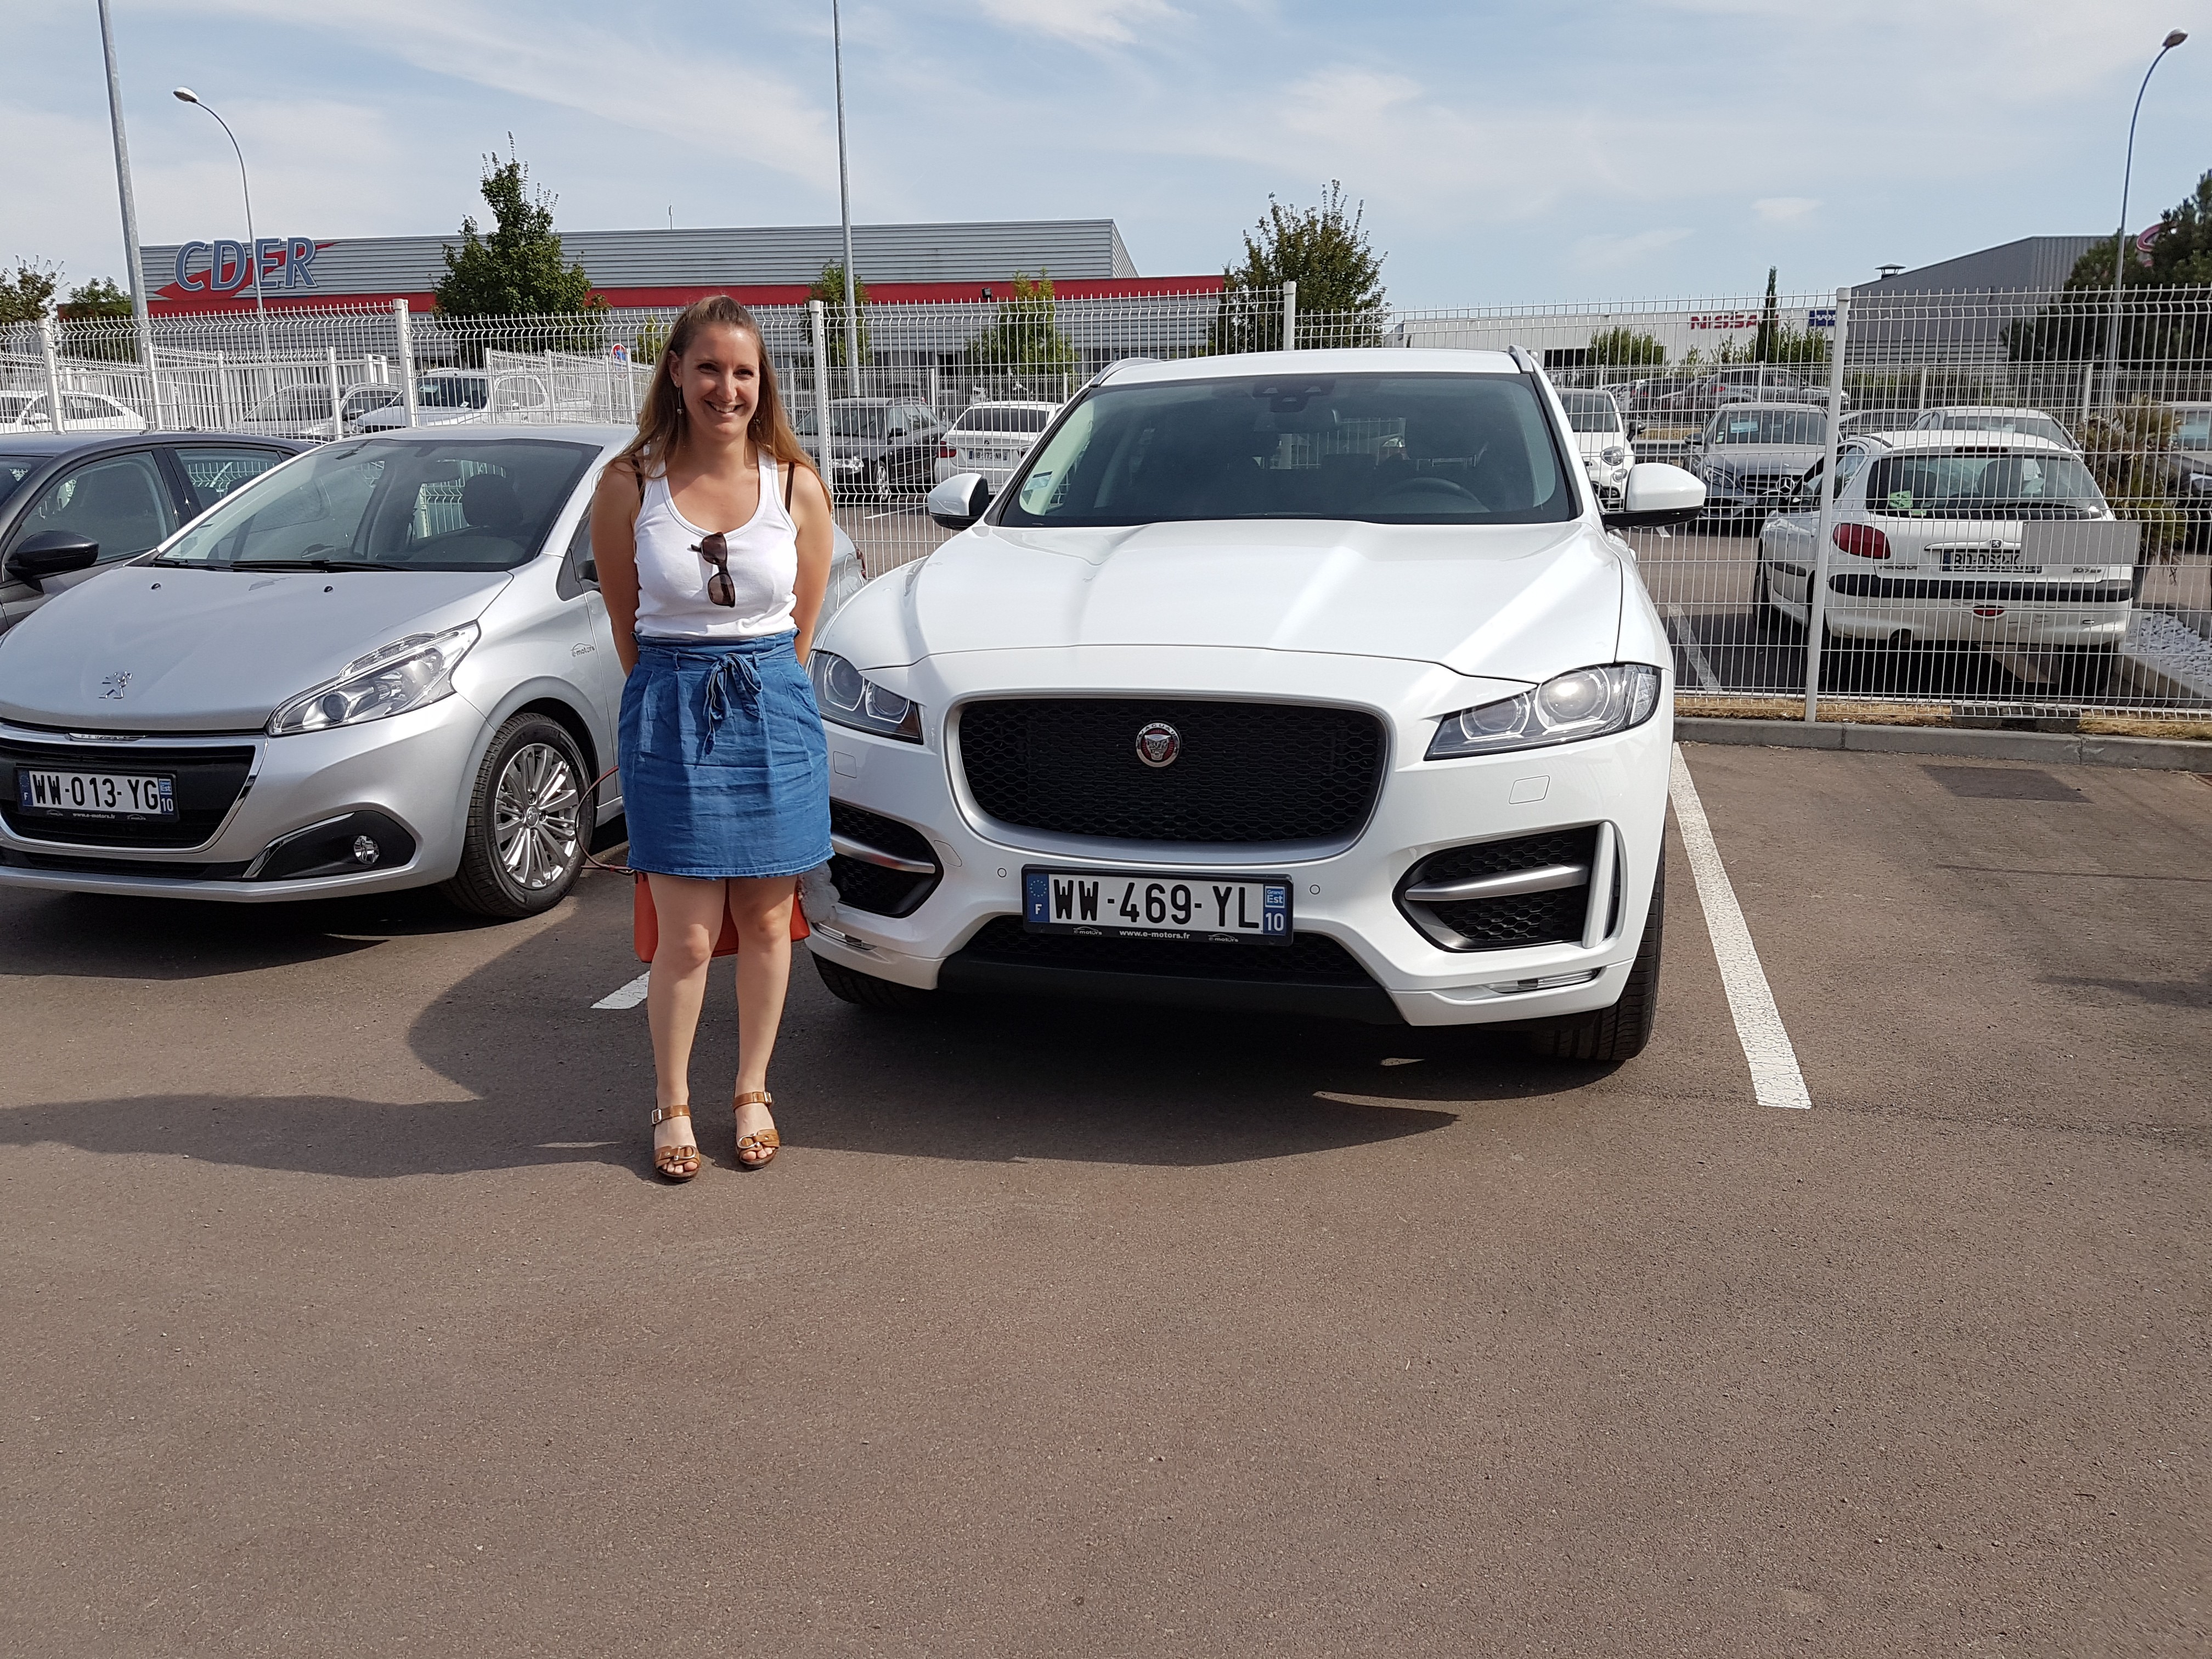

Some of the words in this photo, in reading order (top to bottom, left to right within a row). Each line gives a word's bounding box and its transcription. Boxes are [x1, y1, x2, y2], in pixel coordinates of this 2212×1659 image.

[174, 236, 318, 291] CDER
[1138, 724, 1177, 737] JAGUAR
[24, 792, 29, 800] F
[161, 798, 174, 812] 10
[1053, 879, 1259, 929] WW-469-YL
[1267, 895, 1283, 904] Est
[1035, 904, 1042, 915] F
[1265, 912, 1284, 931] 10
[1119, 930, 1190, 940] www.e-motors.fr
